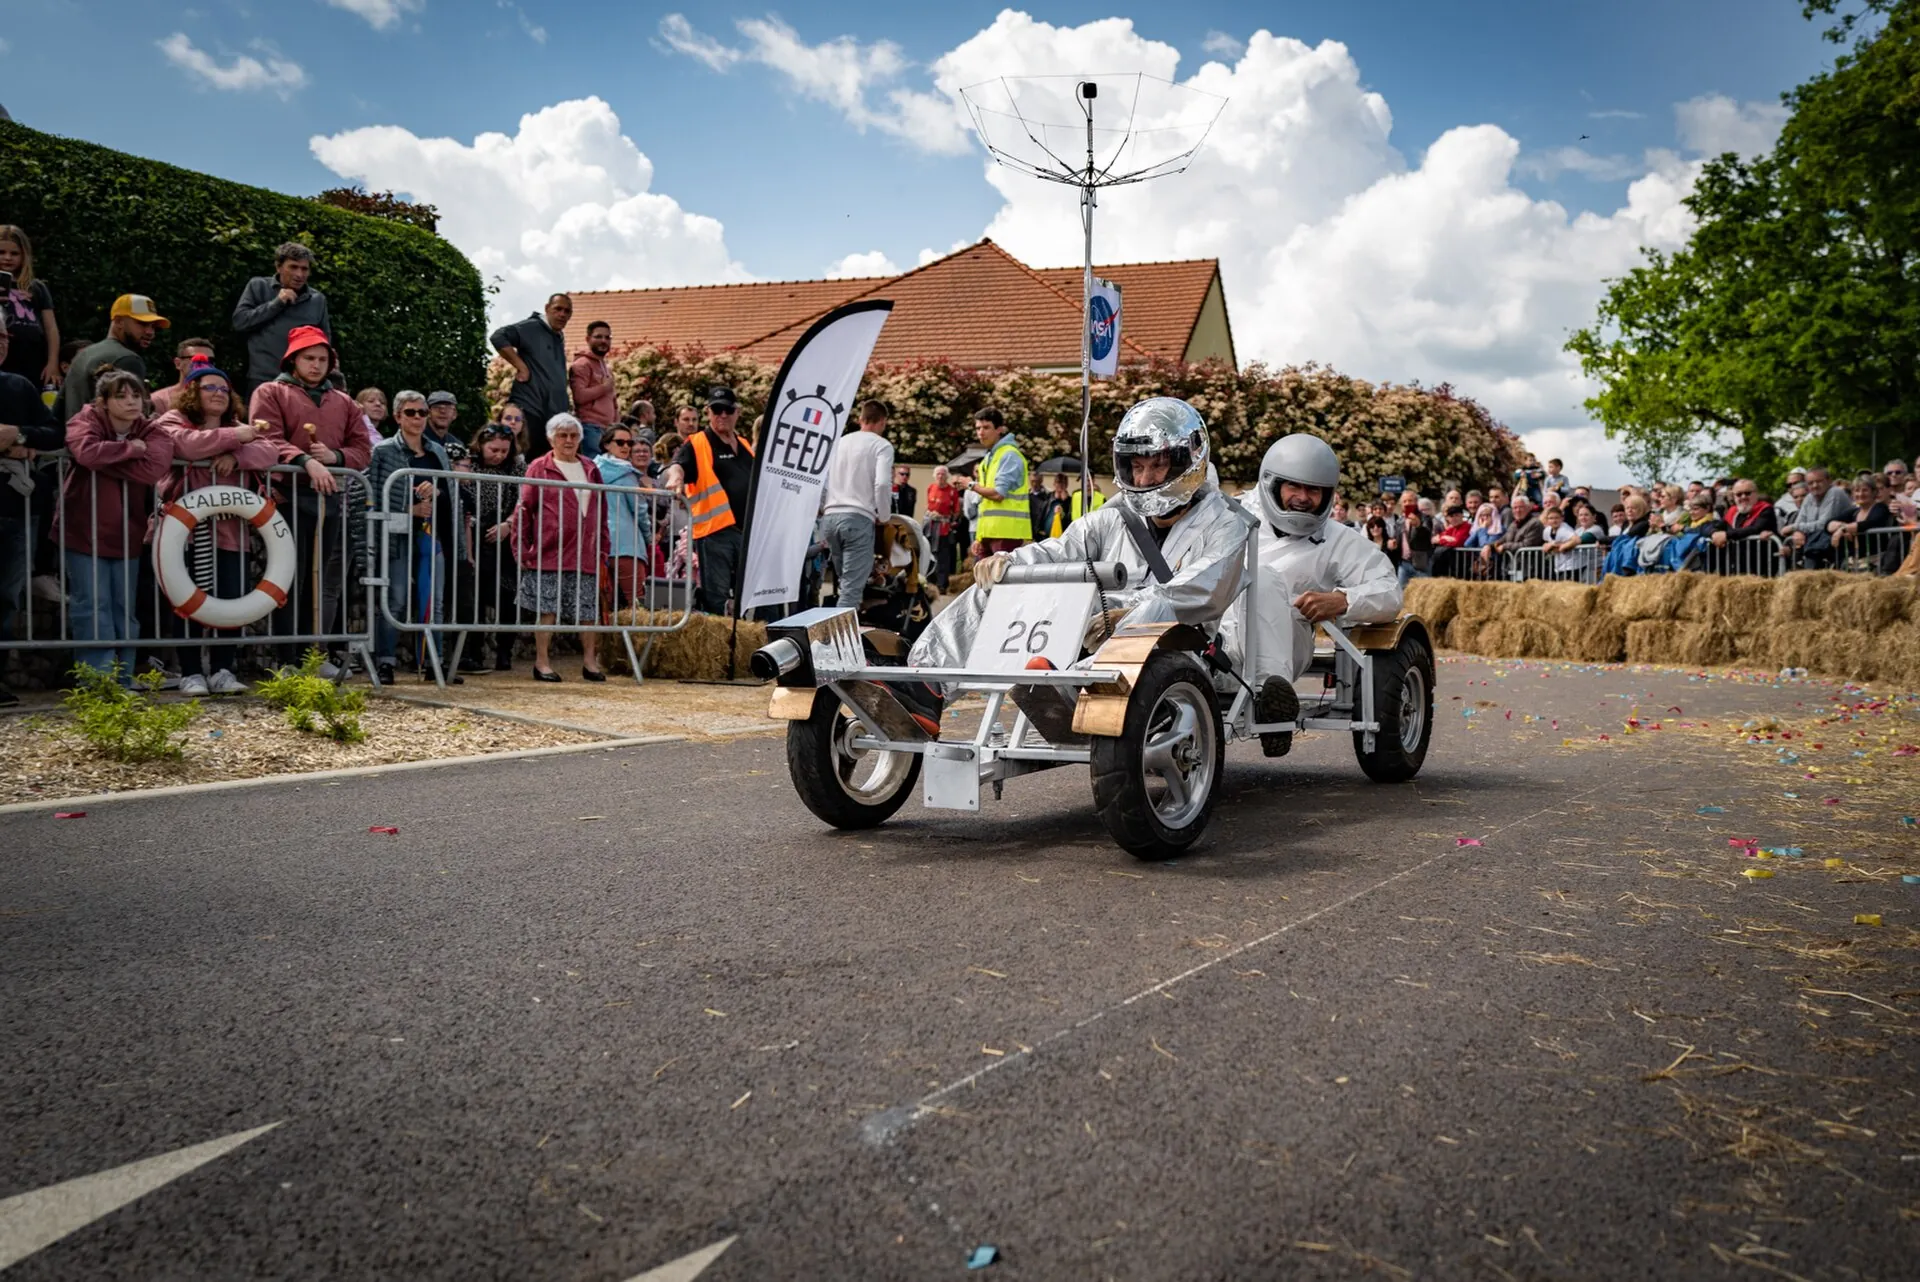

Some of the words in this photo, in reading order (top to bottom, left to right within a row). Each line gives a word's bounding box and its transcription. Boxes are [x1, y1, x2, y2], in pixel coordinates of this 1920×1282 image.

[1091, 319, 1112, 338] ASA
[767, 421, 834, 475] FEED
[780, 478, 803, 495] Racing
[999, 620, 1053, 654] 26
